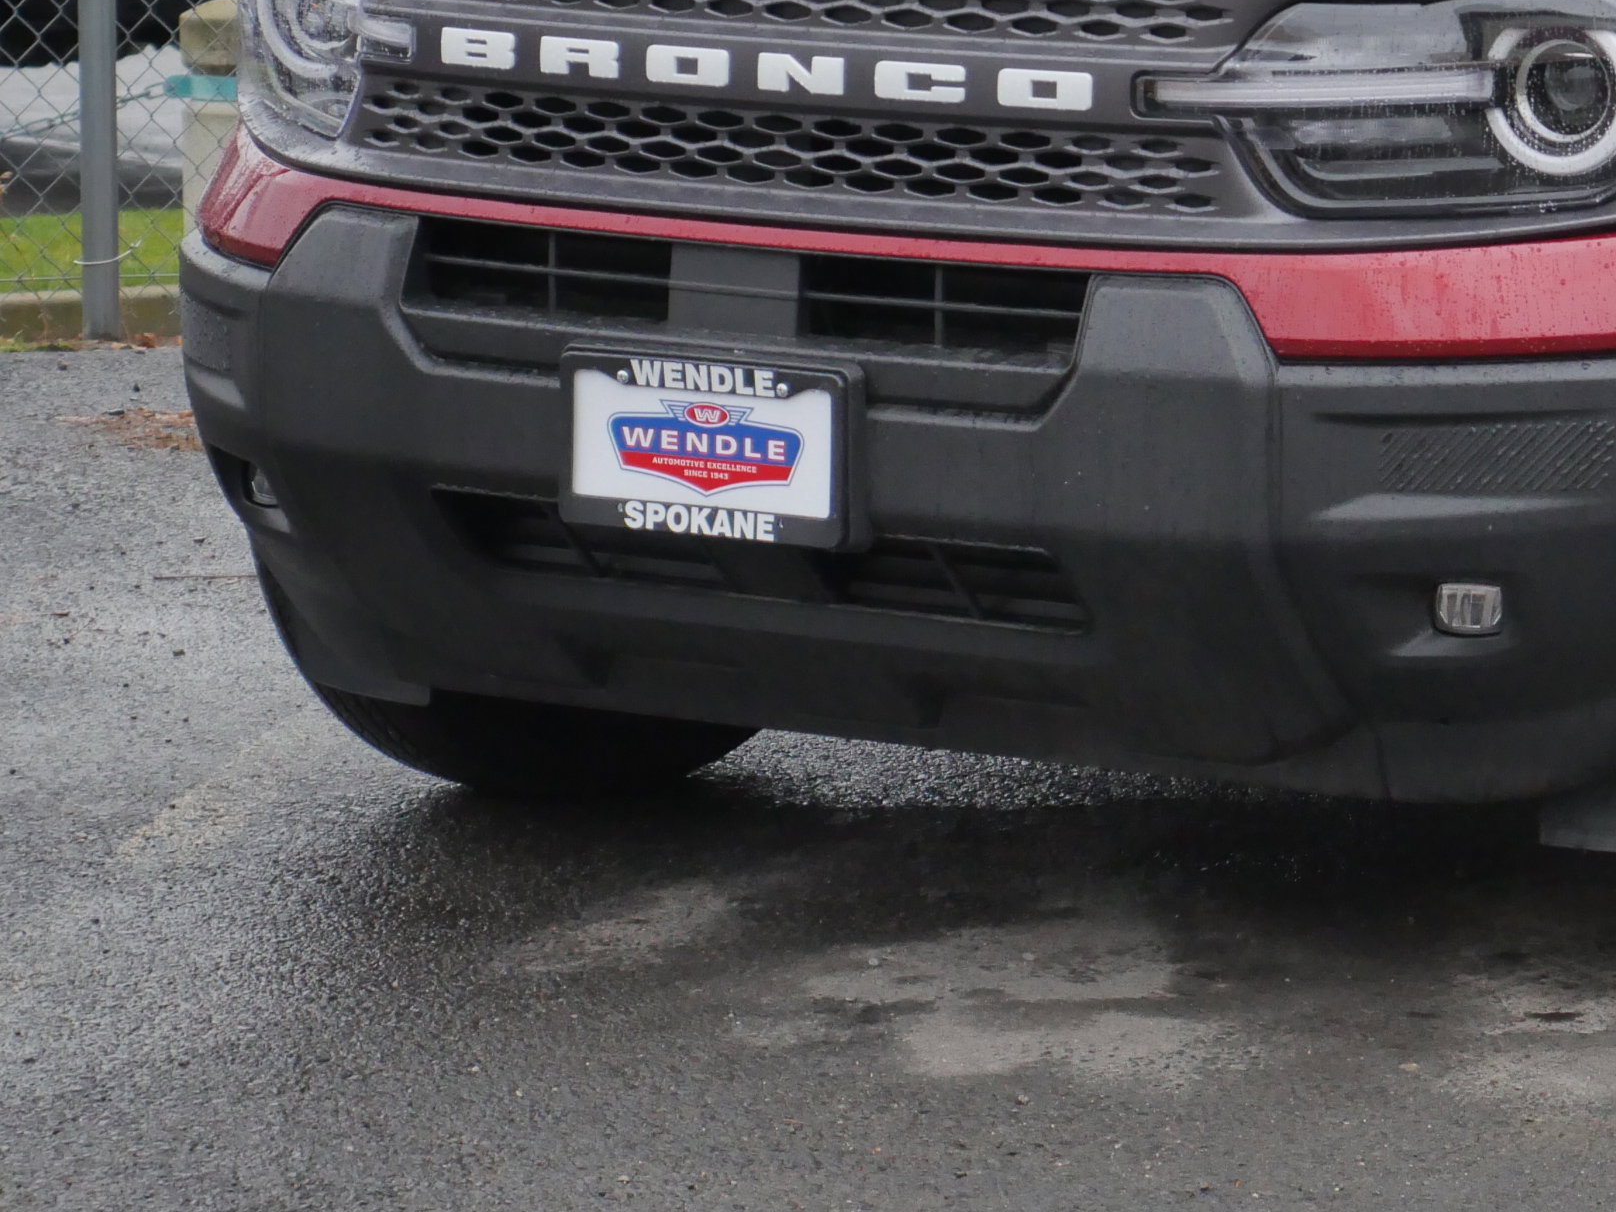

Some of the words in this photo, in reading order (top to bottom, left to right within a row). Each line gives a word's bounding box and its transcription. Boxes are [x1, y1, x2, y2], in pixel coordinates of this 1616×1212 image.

[440, 26, 1094, 111] BRONCO
[630, 359, 776, 398] WENDLE
[621, 425, 787, 462] WENDLE
[652, 456, 705, 468] AUTOMOTIVE
[706, 461, 757, 474] EXCELLENCE
[683, 469, 708, 478] SINCE
[710, 471, 729, 481] 1943
[623, 501, 775, 543] SPOKANE
